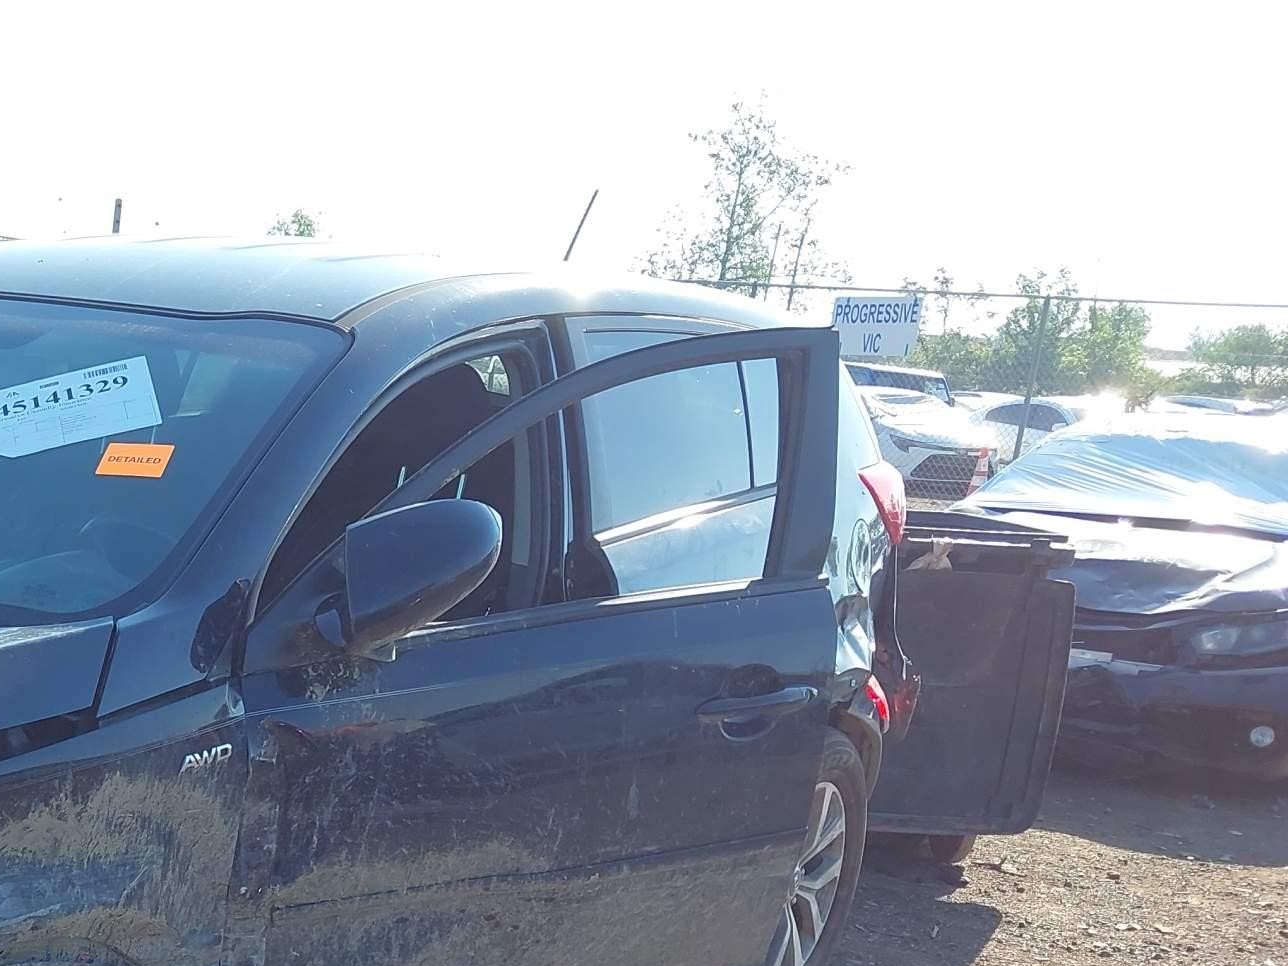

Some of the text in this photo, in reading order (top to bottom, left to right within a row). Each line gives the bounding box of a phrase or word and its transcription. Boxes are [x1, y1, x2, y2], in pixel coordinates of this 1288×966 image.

[834, 302, 919, 324] PROGRESSIVE
[862, 332, 882, 354] VIC
[107, 454, 161, 465] DETAILED
[178, 743, 233, 777] AWD
